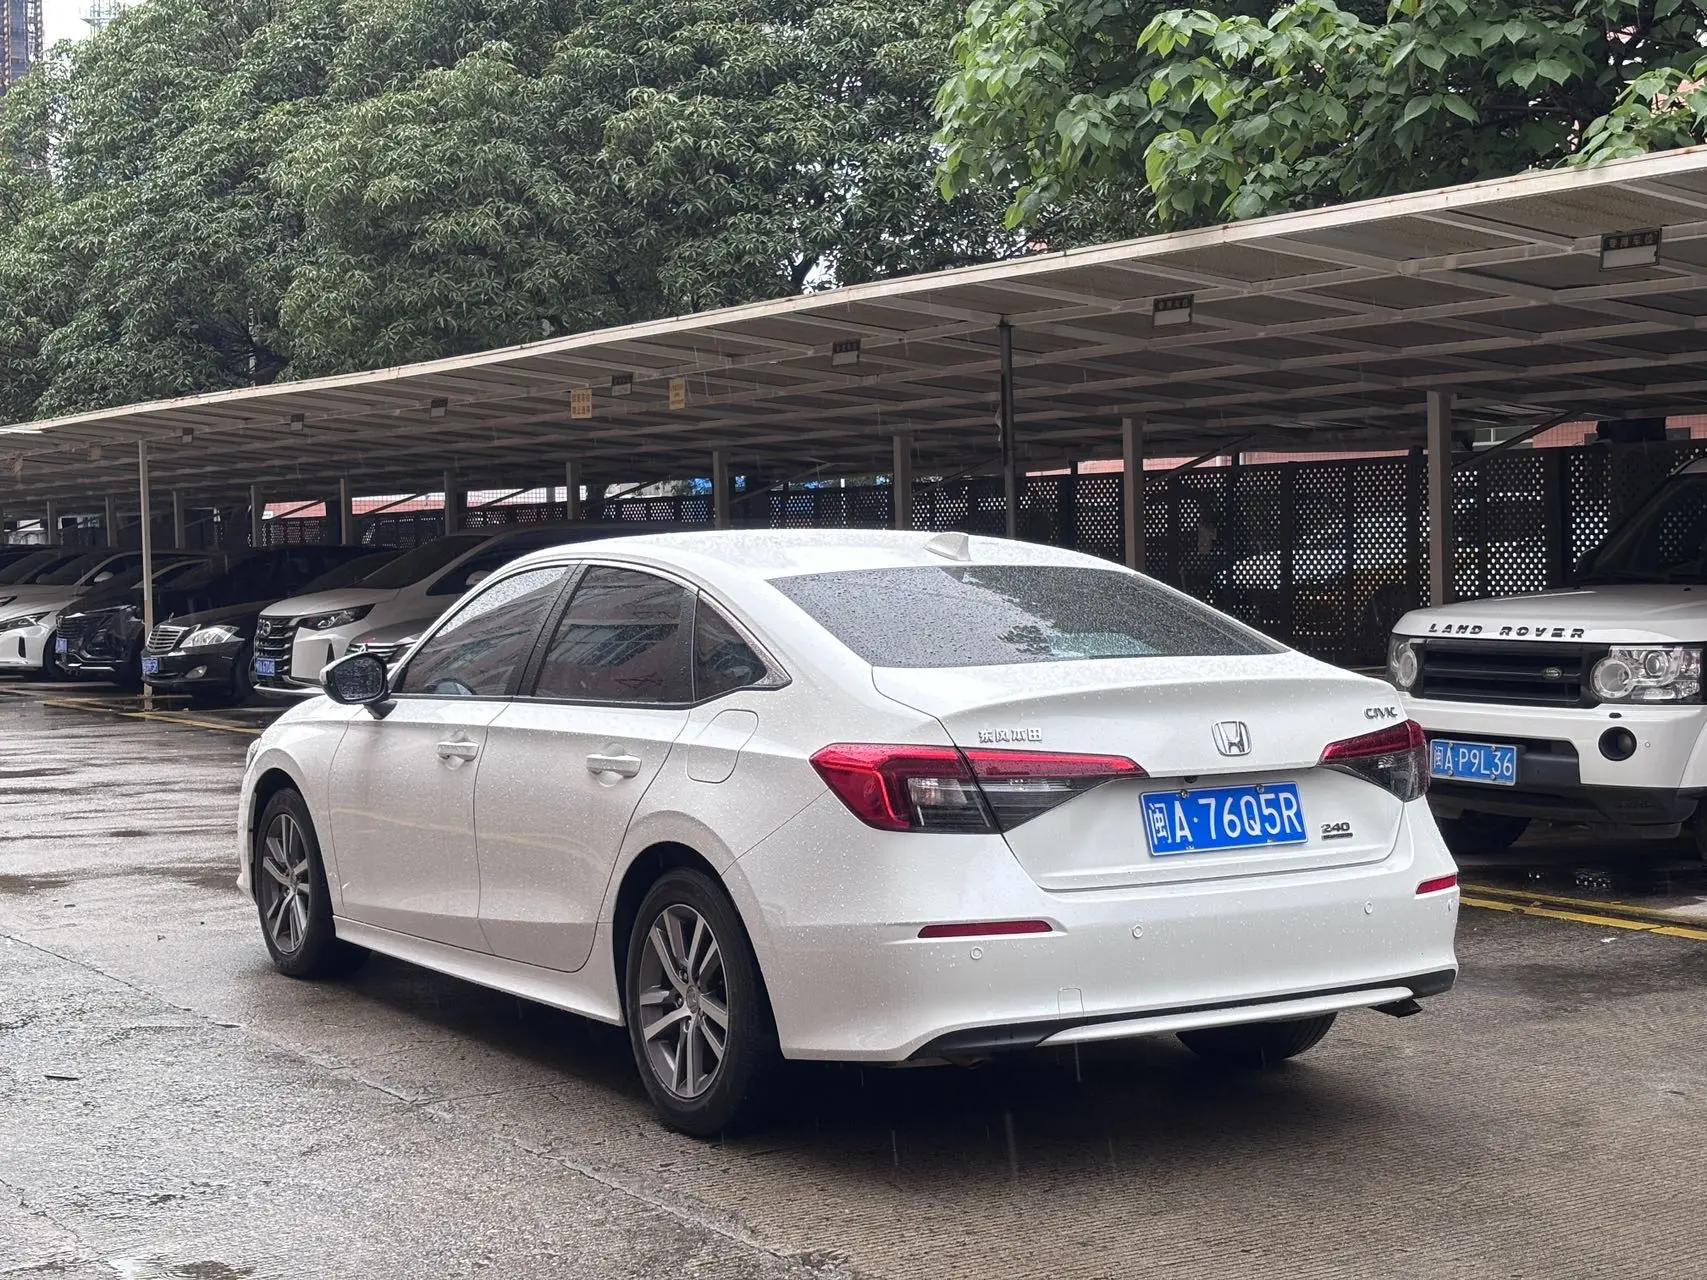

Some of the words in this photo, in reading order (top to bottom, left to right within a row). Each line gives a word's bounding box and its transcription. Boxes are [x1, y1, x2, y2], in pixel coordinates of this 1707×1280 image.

[1428, 623, 1483, 635] LAND
[1499, 625, 1585, 639] ROVER
[1364, 706, 1398, 720] CIVIC
[978, 727, 1043, 744] 东风本田
[1320, 822, 1351, 834] 240
